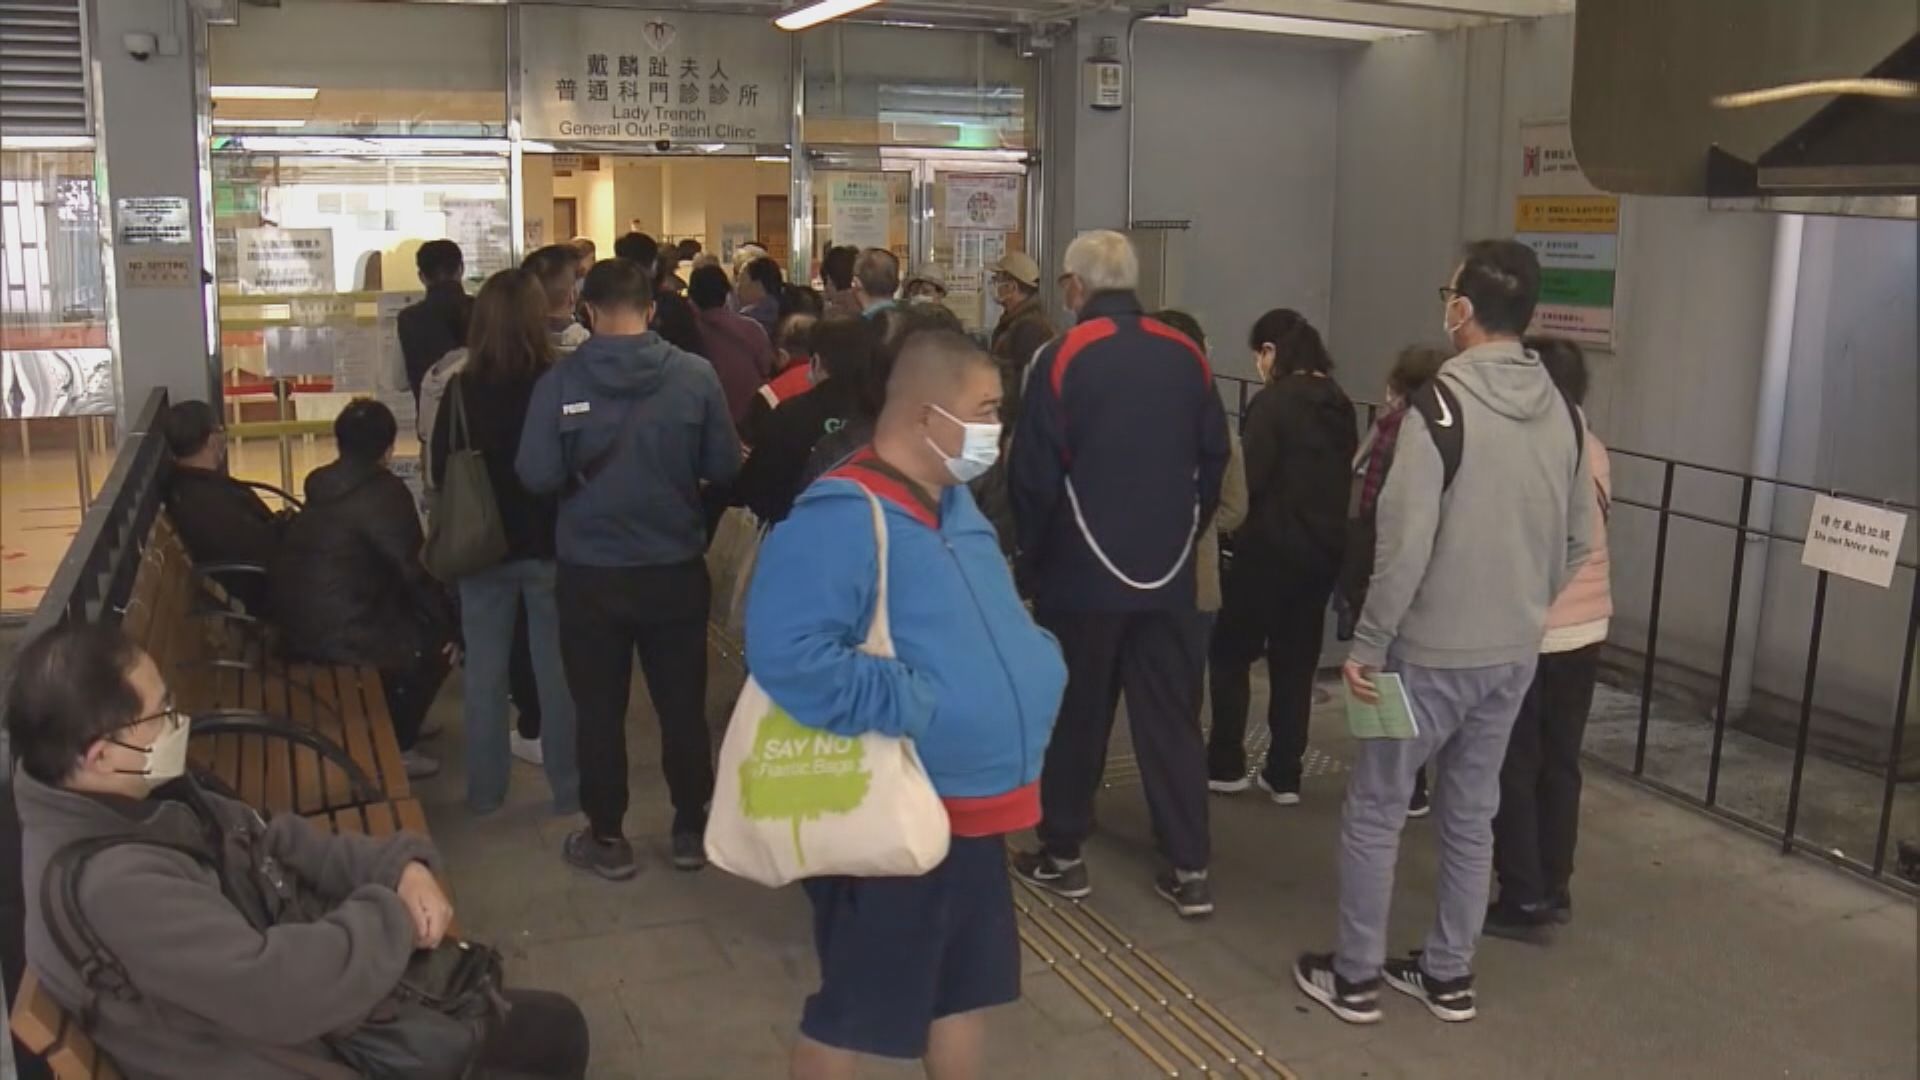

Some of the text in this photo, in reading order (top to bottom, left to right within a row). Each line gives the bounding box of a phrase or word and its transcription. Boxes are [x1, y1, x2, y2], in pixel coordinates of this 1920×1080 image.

[587, 53, 729, 80] 戴麟趾夫人
[556, 79, 759, 107] 普通科門診診所
[612, 104, 707, 121] Lady Trench
[558, 121, 757, 139] General Out-Patient Clinic
[1820, 515, 1891, 542] 請勿亂拋垃圾
[1814, 530, 1889, 558] Do not litter here
[763, 734, 851, 760] SAY NO
